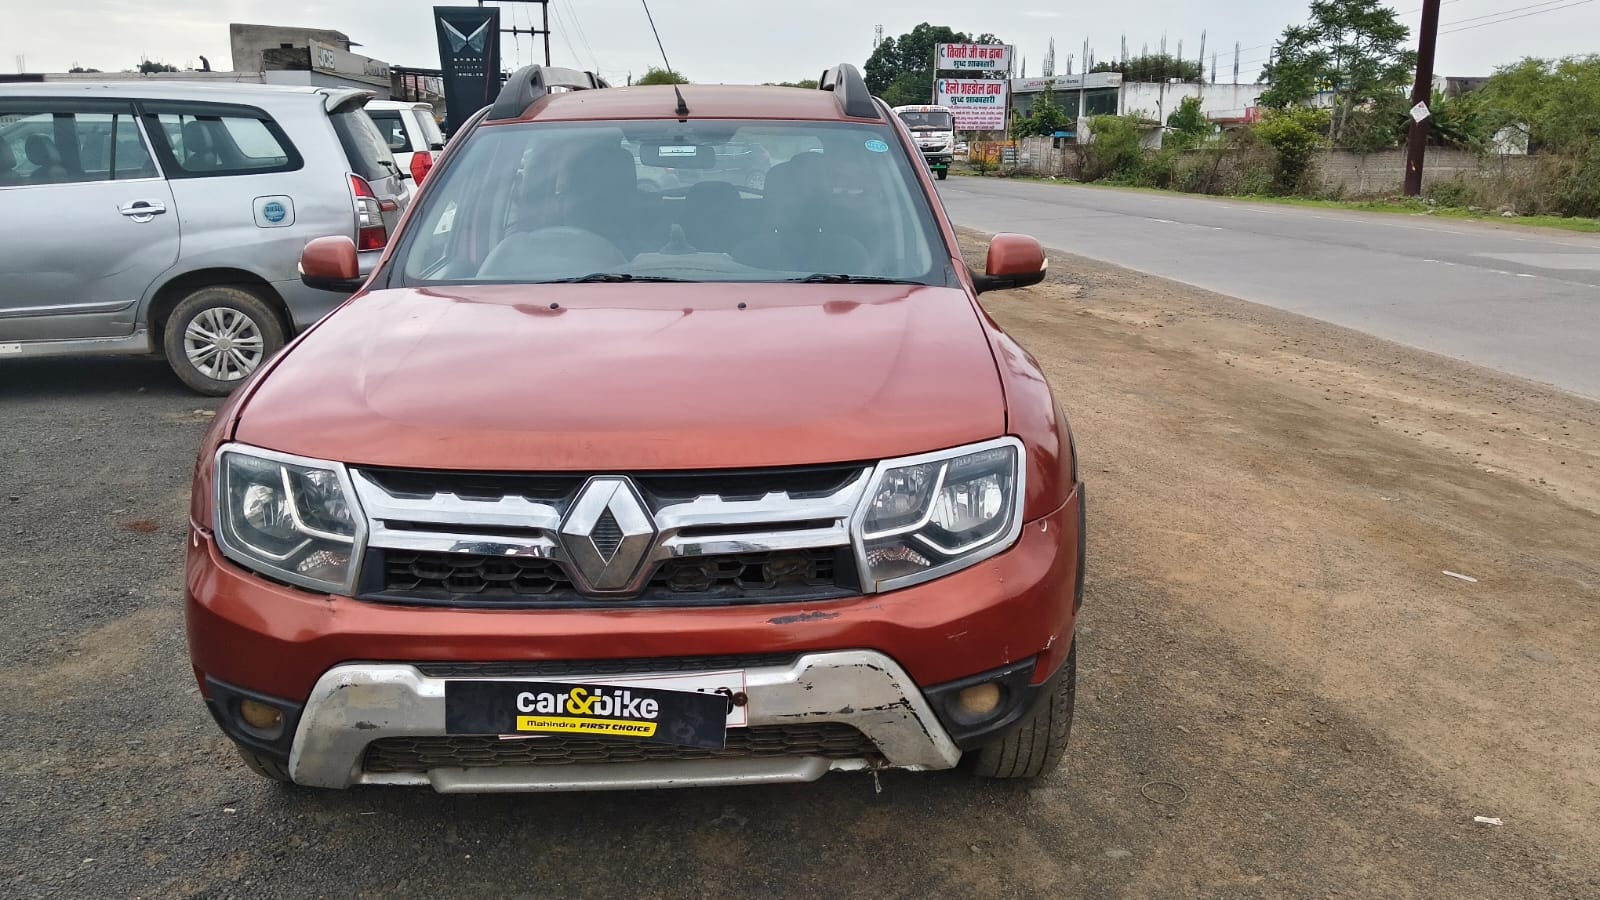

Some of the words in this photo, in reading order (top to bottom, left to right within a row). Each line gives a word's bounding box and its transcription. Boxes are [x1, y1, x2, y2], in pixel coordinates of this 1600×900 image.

[947, 44, 967, 59] तिवारी
[969, 44, 977, 59] जी
[979, 48, 987, 59] का
[945, 80, 959, 94] हेलो
[961, 80, 985, 94] शहडोल
[516, 687, 659, 719] car&bike
[526, 720, 576, 729] Mahindra
[579, 722, 611, 730] FIRST
[612, 724, 651, 733] CHOICE
